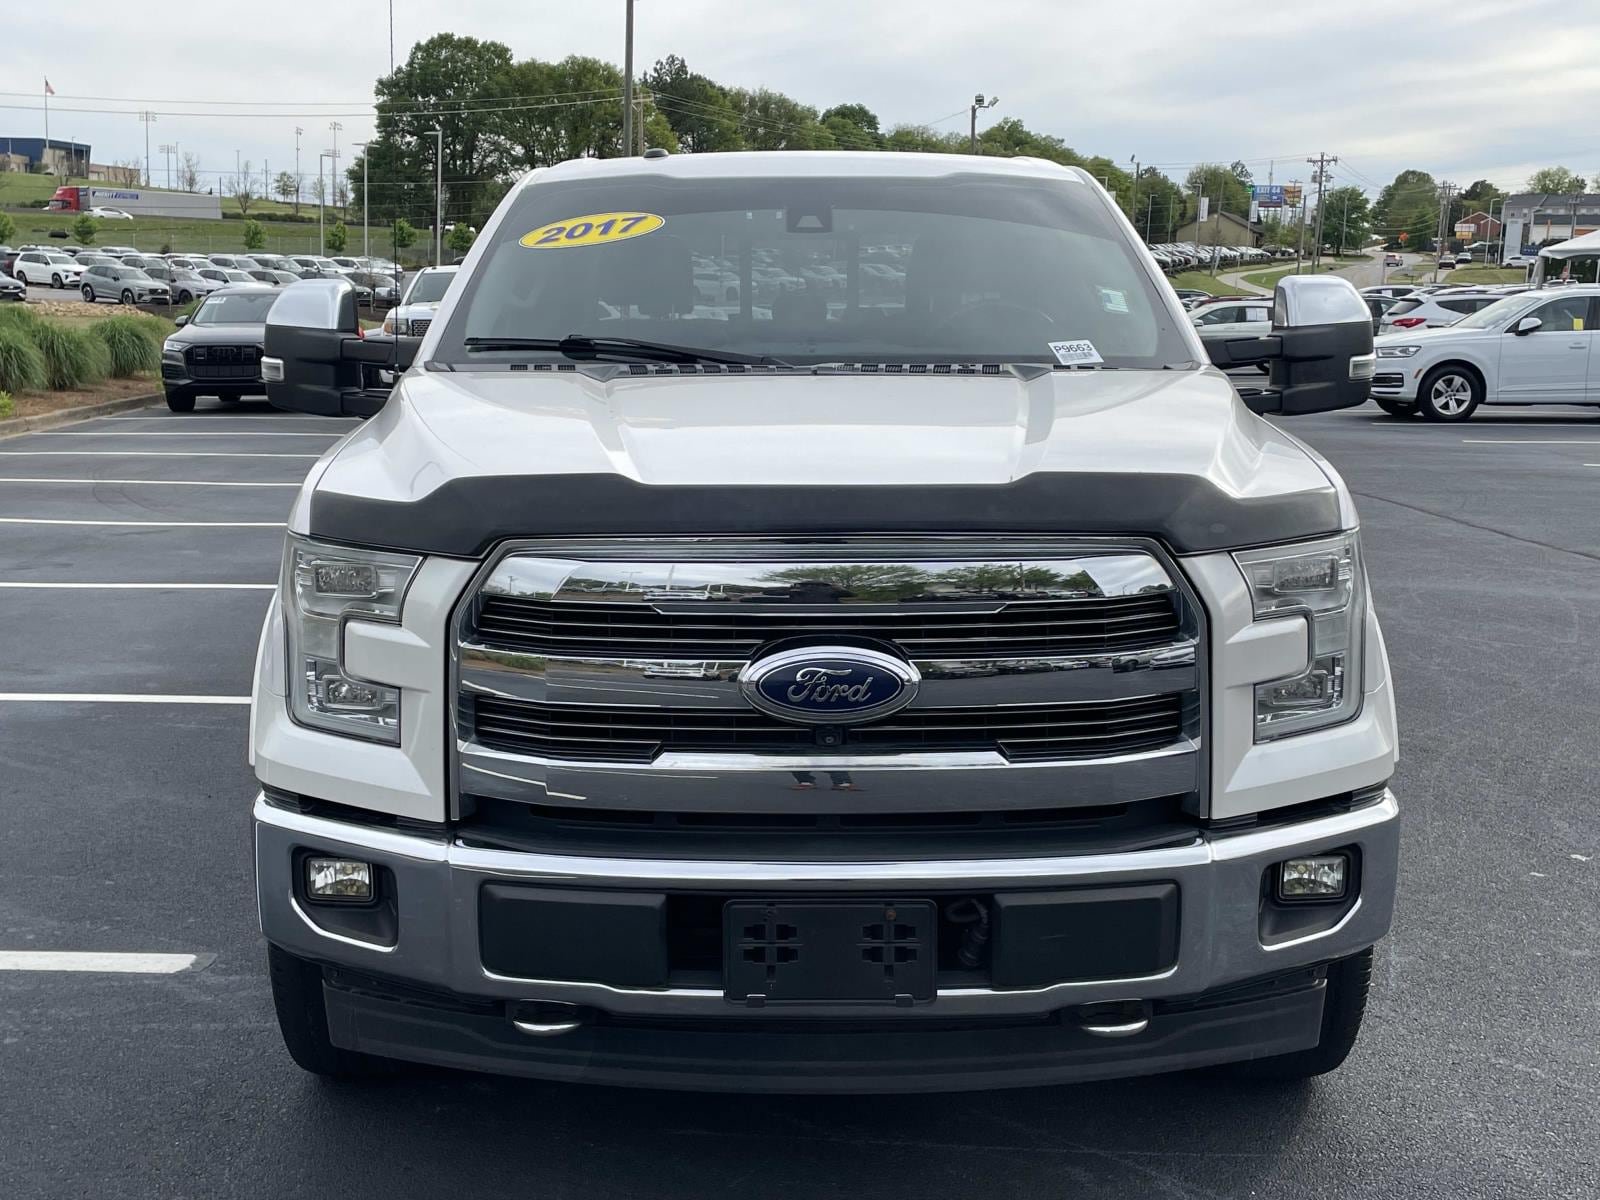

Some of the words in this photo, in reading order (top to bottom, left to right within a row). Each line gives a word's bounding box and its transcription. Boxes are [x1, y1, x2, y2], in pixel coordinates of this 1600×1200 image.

[534, 216, 649, 246] 2017
[1053, 343, 1093, 354] P9663
[787, 667, 874, 703] Ford
